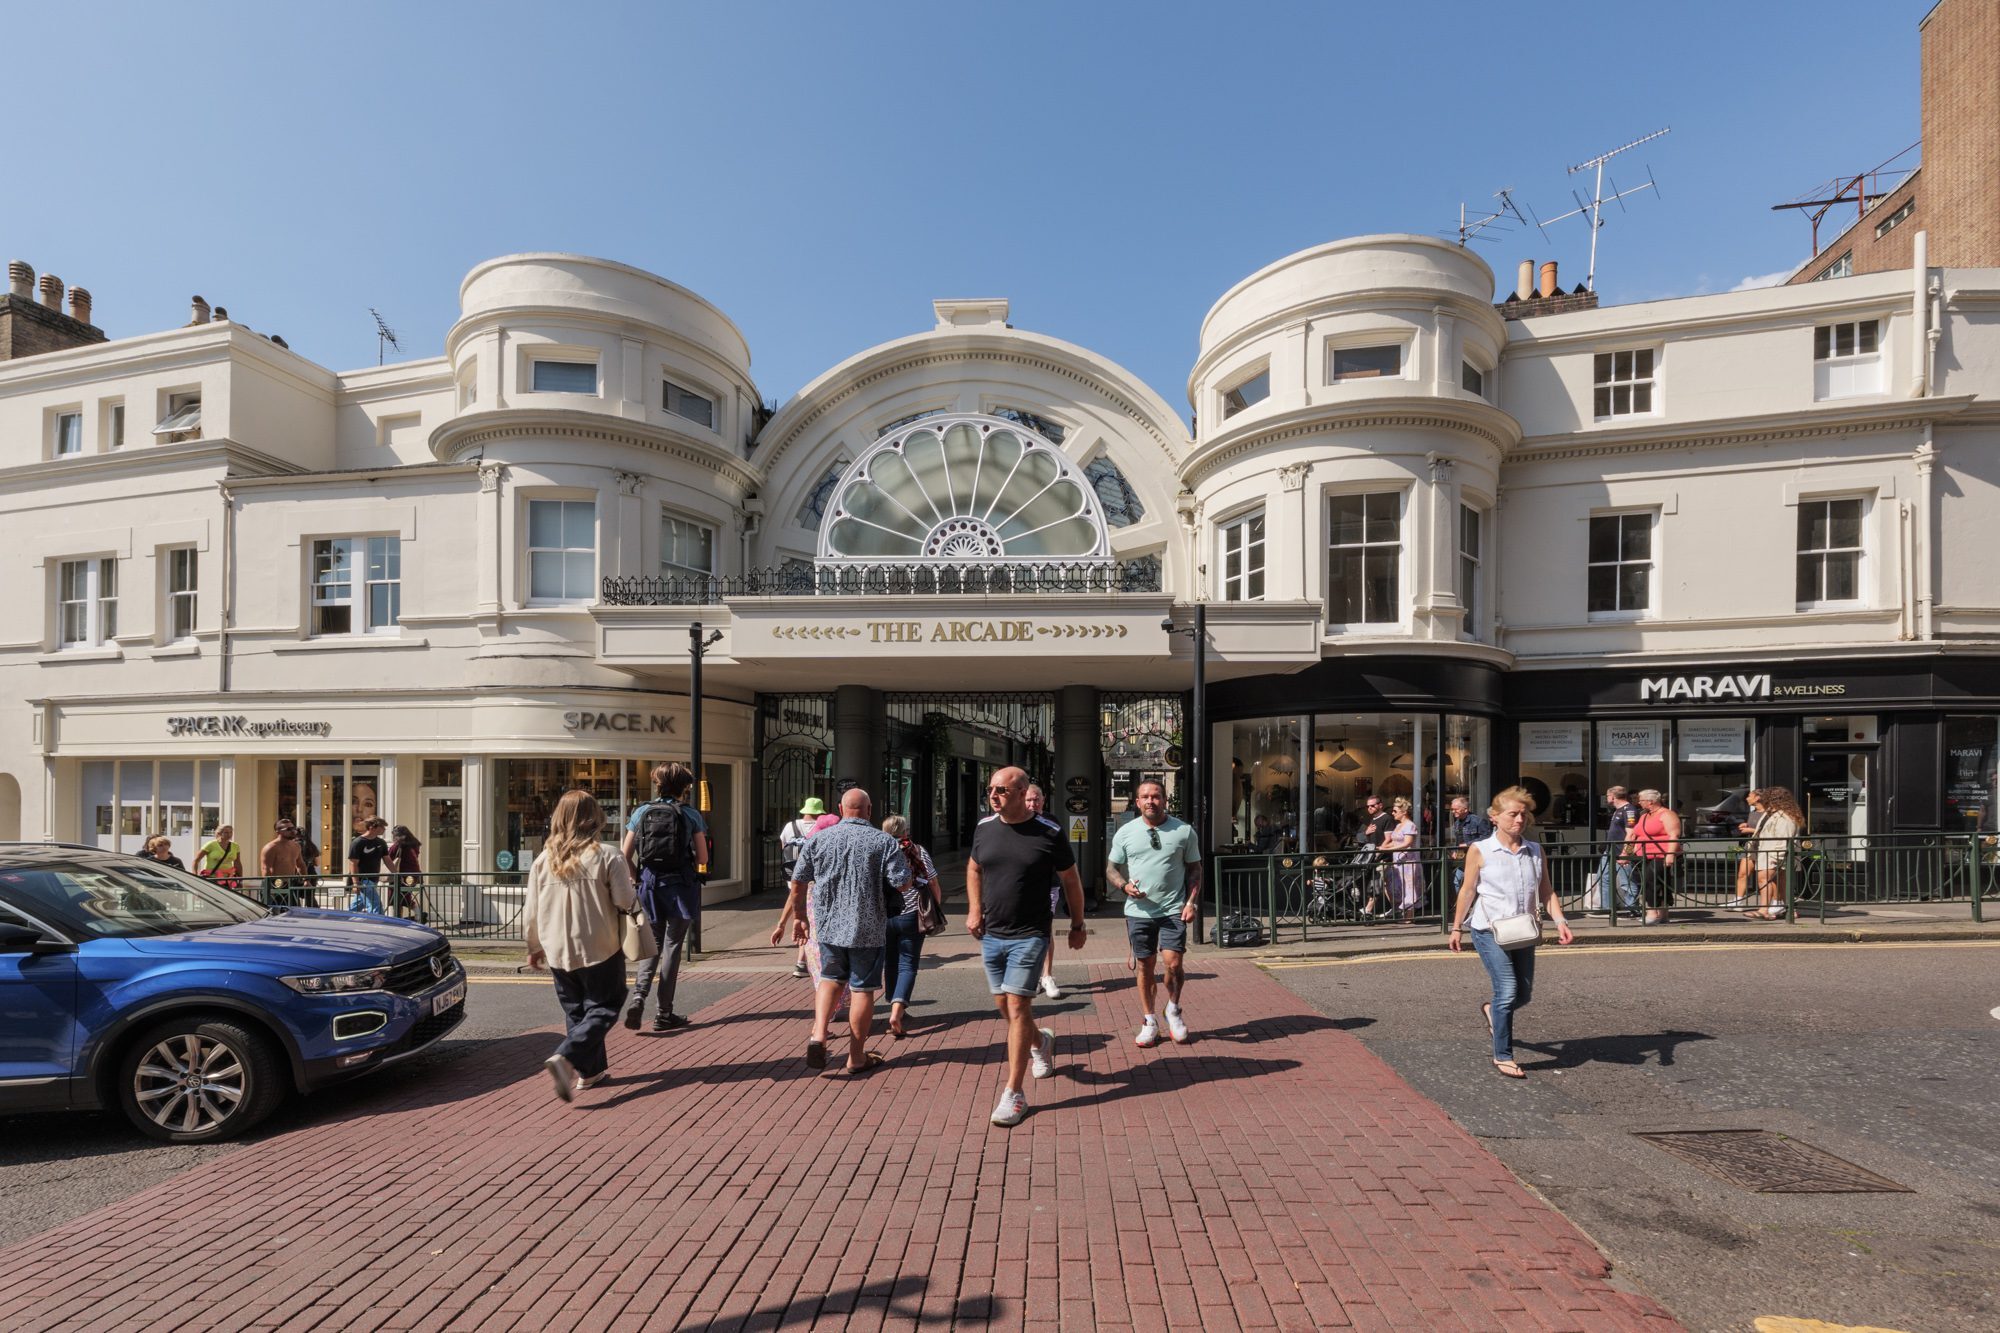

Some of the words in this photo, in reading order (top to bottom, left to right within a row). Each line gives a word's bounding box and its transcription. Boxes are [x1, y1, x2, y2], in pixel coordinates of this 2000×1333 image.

[866, 621, 922, 643] THE
[930, 620, 1034, 643] ARCADE
[1641, 674, 1771, 700] MARAVI
[1773, 686, 1782, 696] &
[1783, 684, 1846, 695] WELLNESS
[563, 711, 676, 734] SPACE.NK
[1950, 749, 1982, 757] MARAVI
